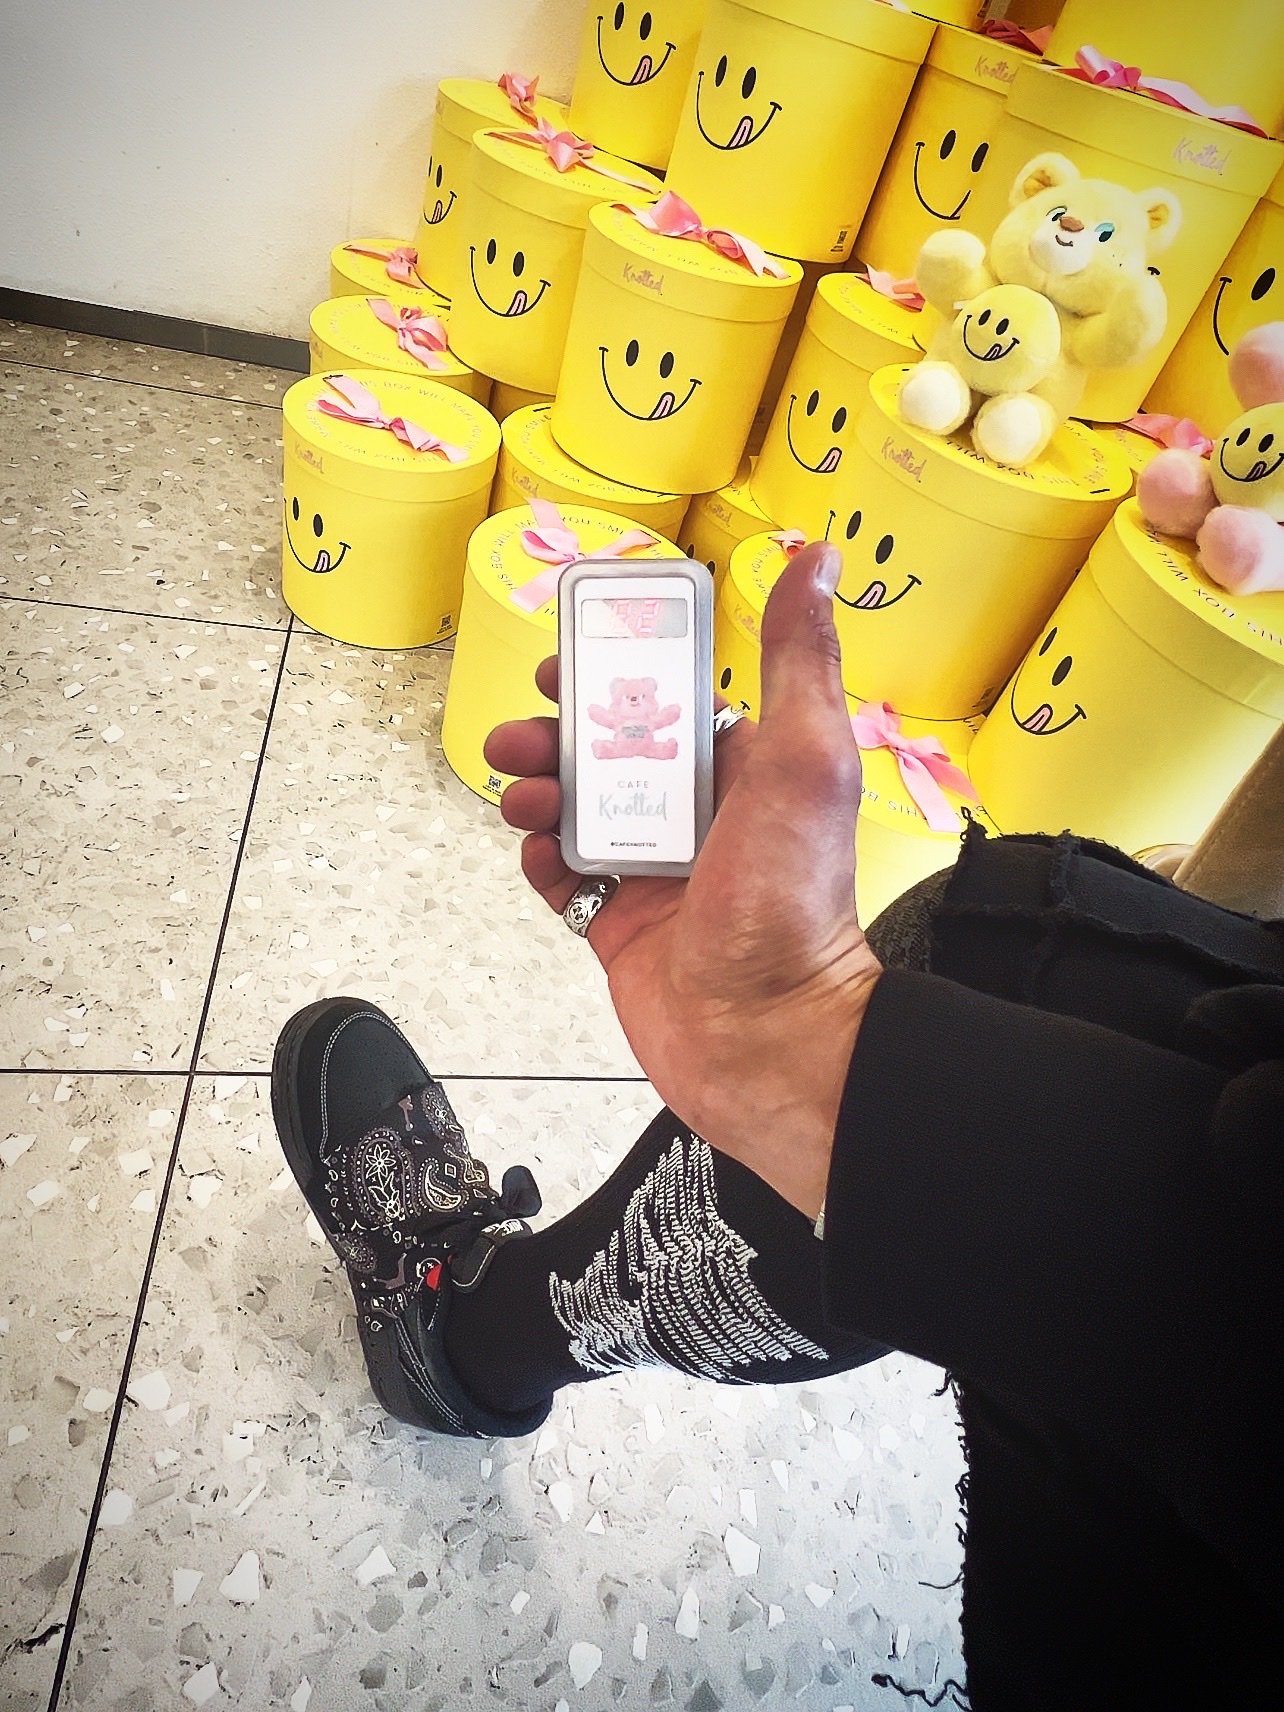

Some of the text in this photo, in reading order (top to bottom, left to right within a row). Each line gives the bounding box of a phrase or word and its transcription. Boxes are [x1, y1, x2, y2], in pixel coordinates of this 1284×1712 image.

[623, 261, 664, 297] Knotted
[881, 437, 927, 483] Knotted
[497, 573, 518, 592] HIS
[1156, 551, 1284, 646] HIS BOX WILL
[617, 780, 649, 790] CAFE
[598, 791, 668, 822] Knotted
[888, 800, 918, 818] HIS
